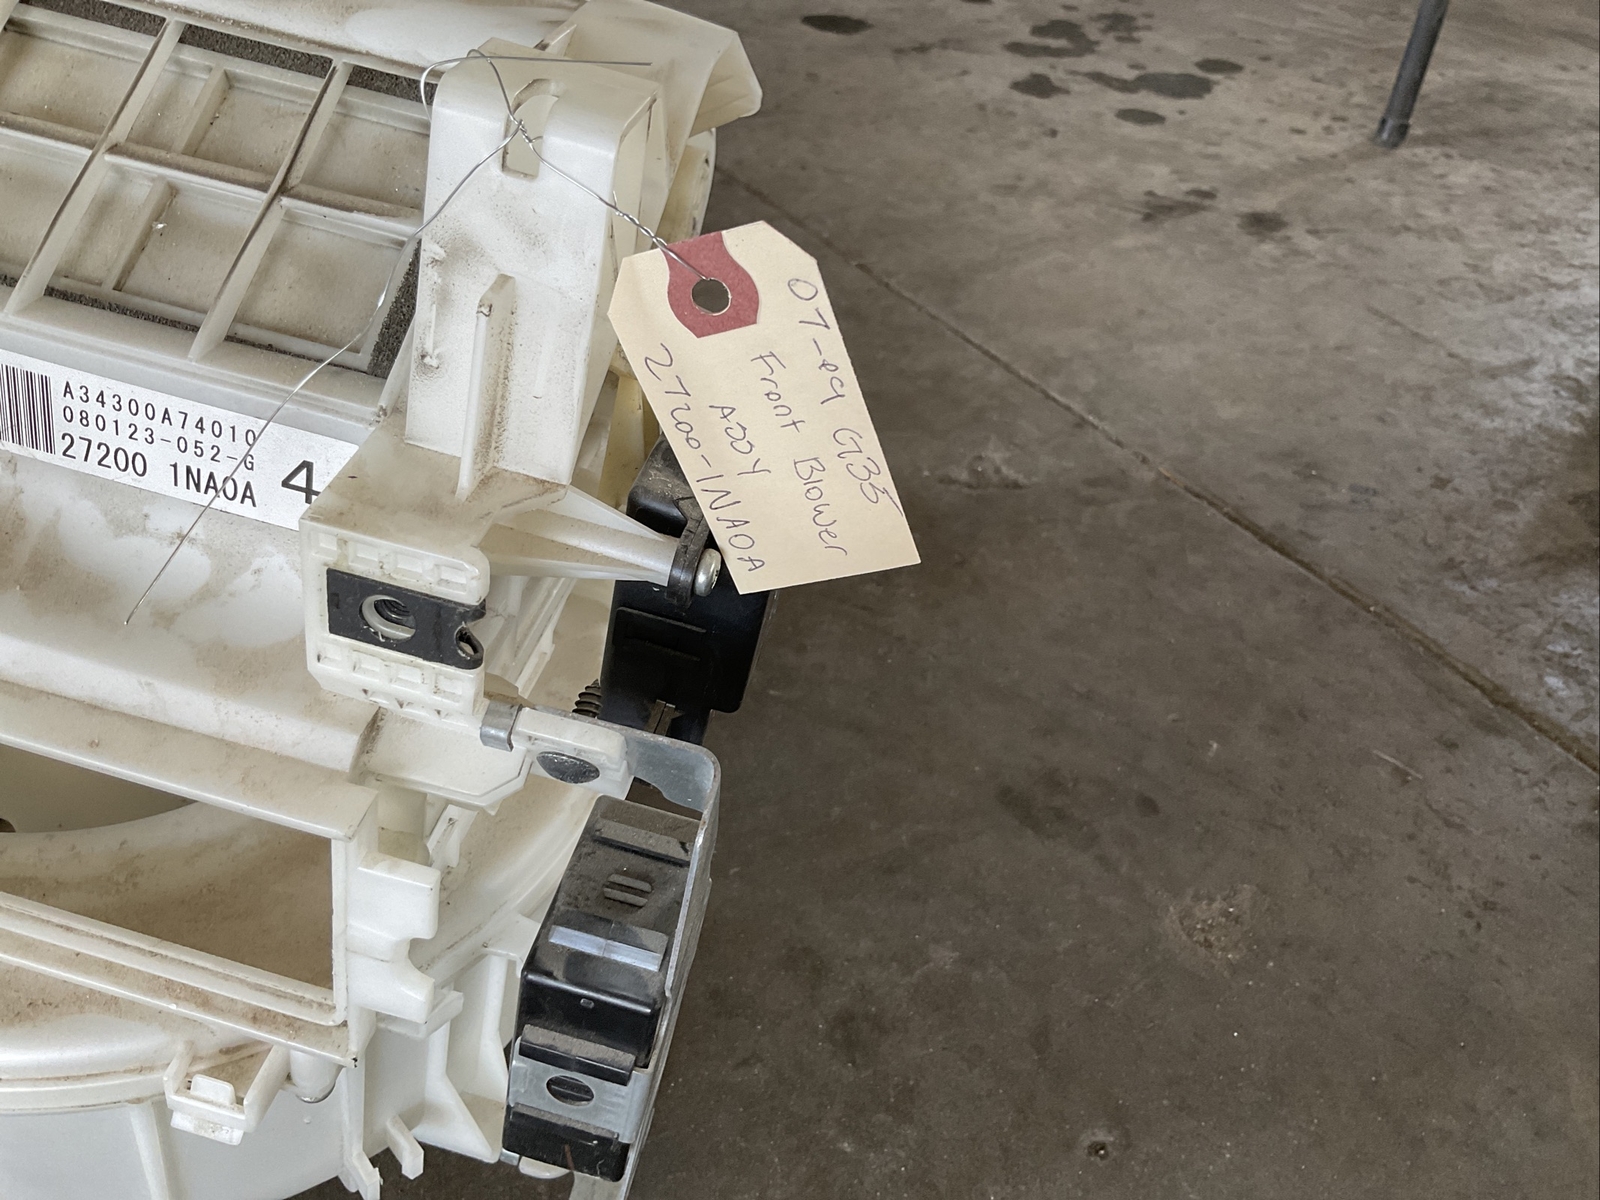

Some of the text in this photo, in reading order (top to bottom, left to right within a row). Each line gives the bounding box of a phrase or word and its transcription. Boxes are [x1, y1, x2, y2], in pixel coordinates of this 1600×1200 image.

[63, 381, 257, 447] A34300A74010
[787, 279, 904, 517] 07-09 G35
[62, 433, 148, 477] 27200
[63, 406, 256, 471] 080123-052-G
[750, 351, 848, 556] Front Blower
[281, 460, 321, 505] 4
